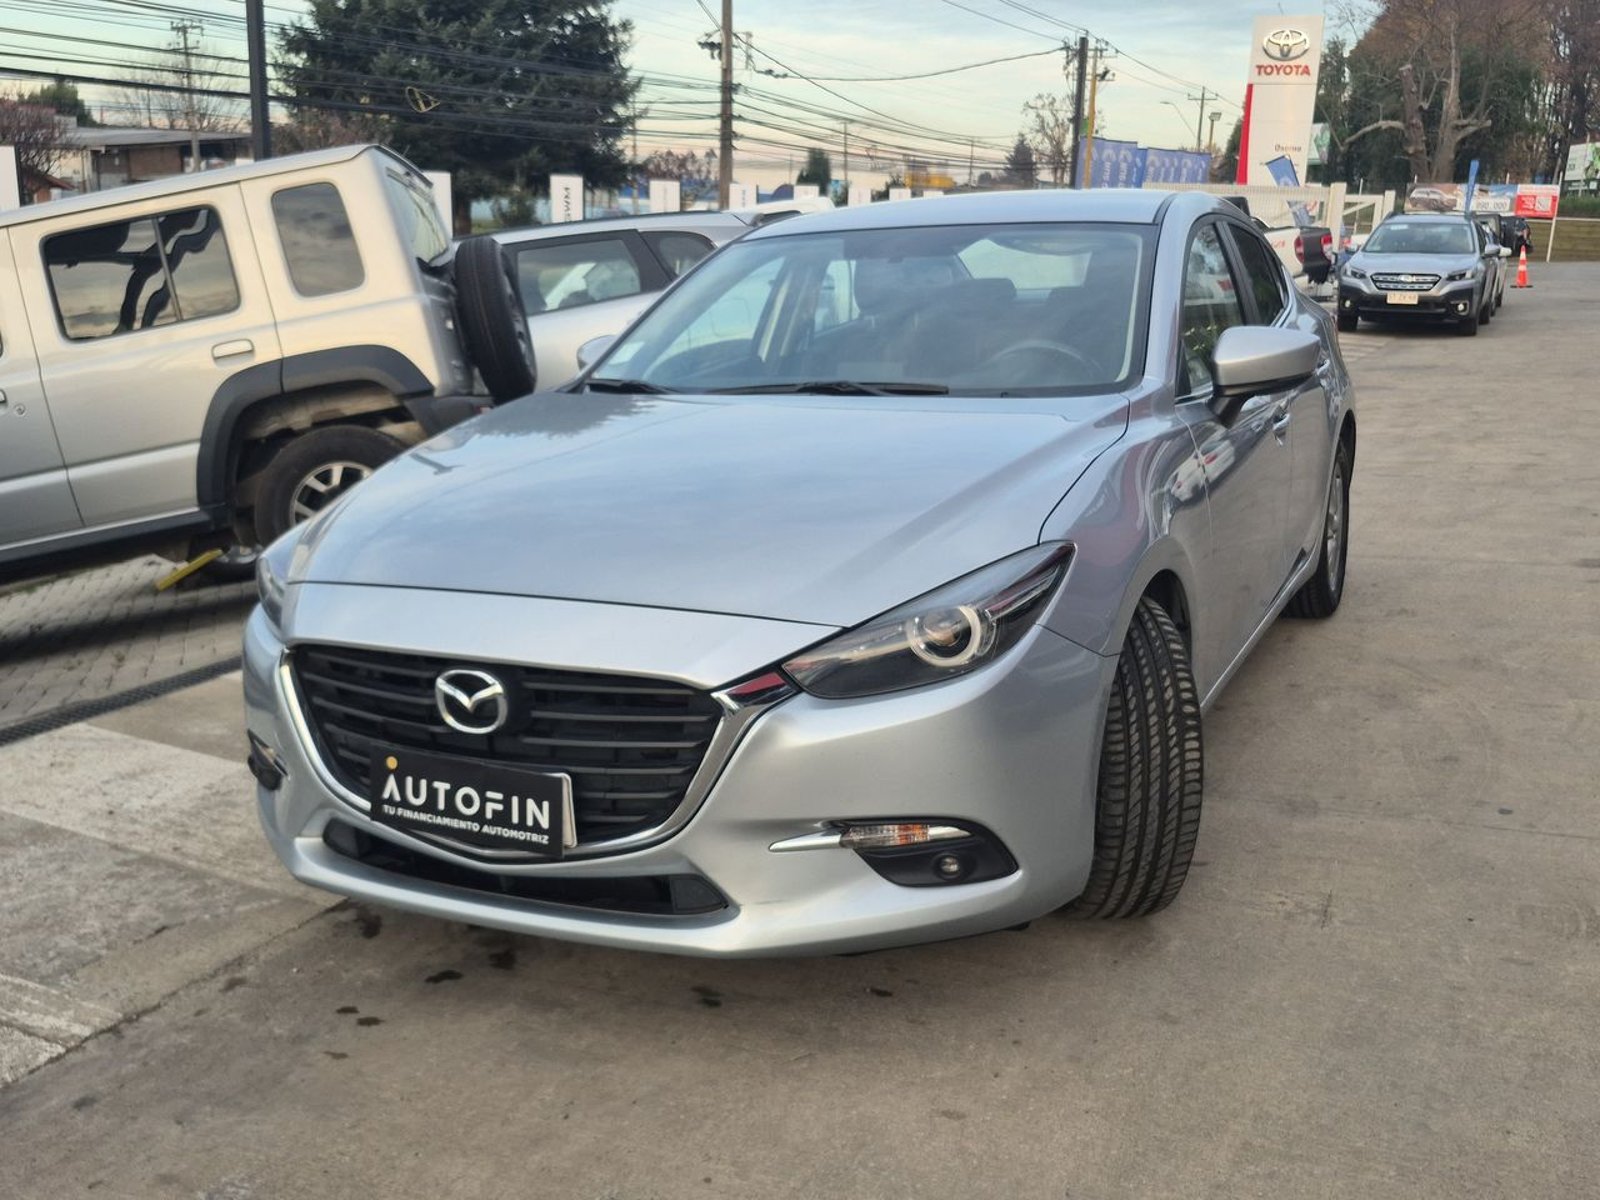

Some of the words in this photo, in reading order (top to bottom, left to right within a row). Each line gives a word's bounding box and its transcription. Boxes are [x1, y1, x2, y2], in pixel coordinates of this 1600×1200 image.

[1256, 64, 1311, 76] TOYOTA
[382, 773, 550, 829] AUTOFIN
[383, 804, 396, 816] TU
[397, 809, 481, 833] FINANCIAMIENTO
[481, 825, 549, 844] AUTOMOTRIZ
